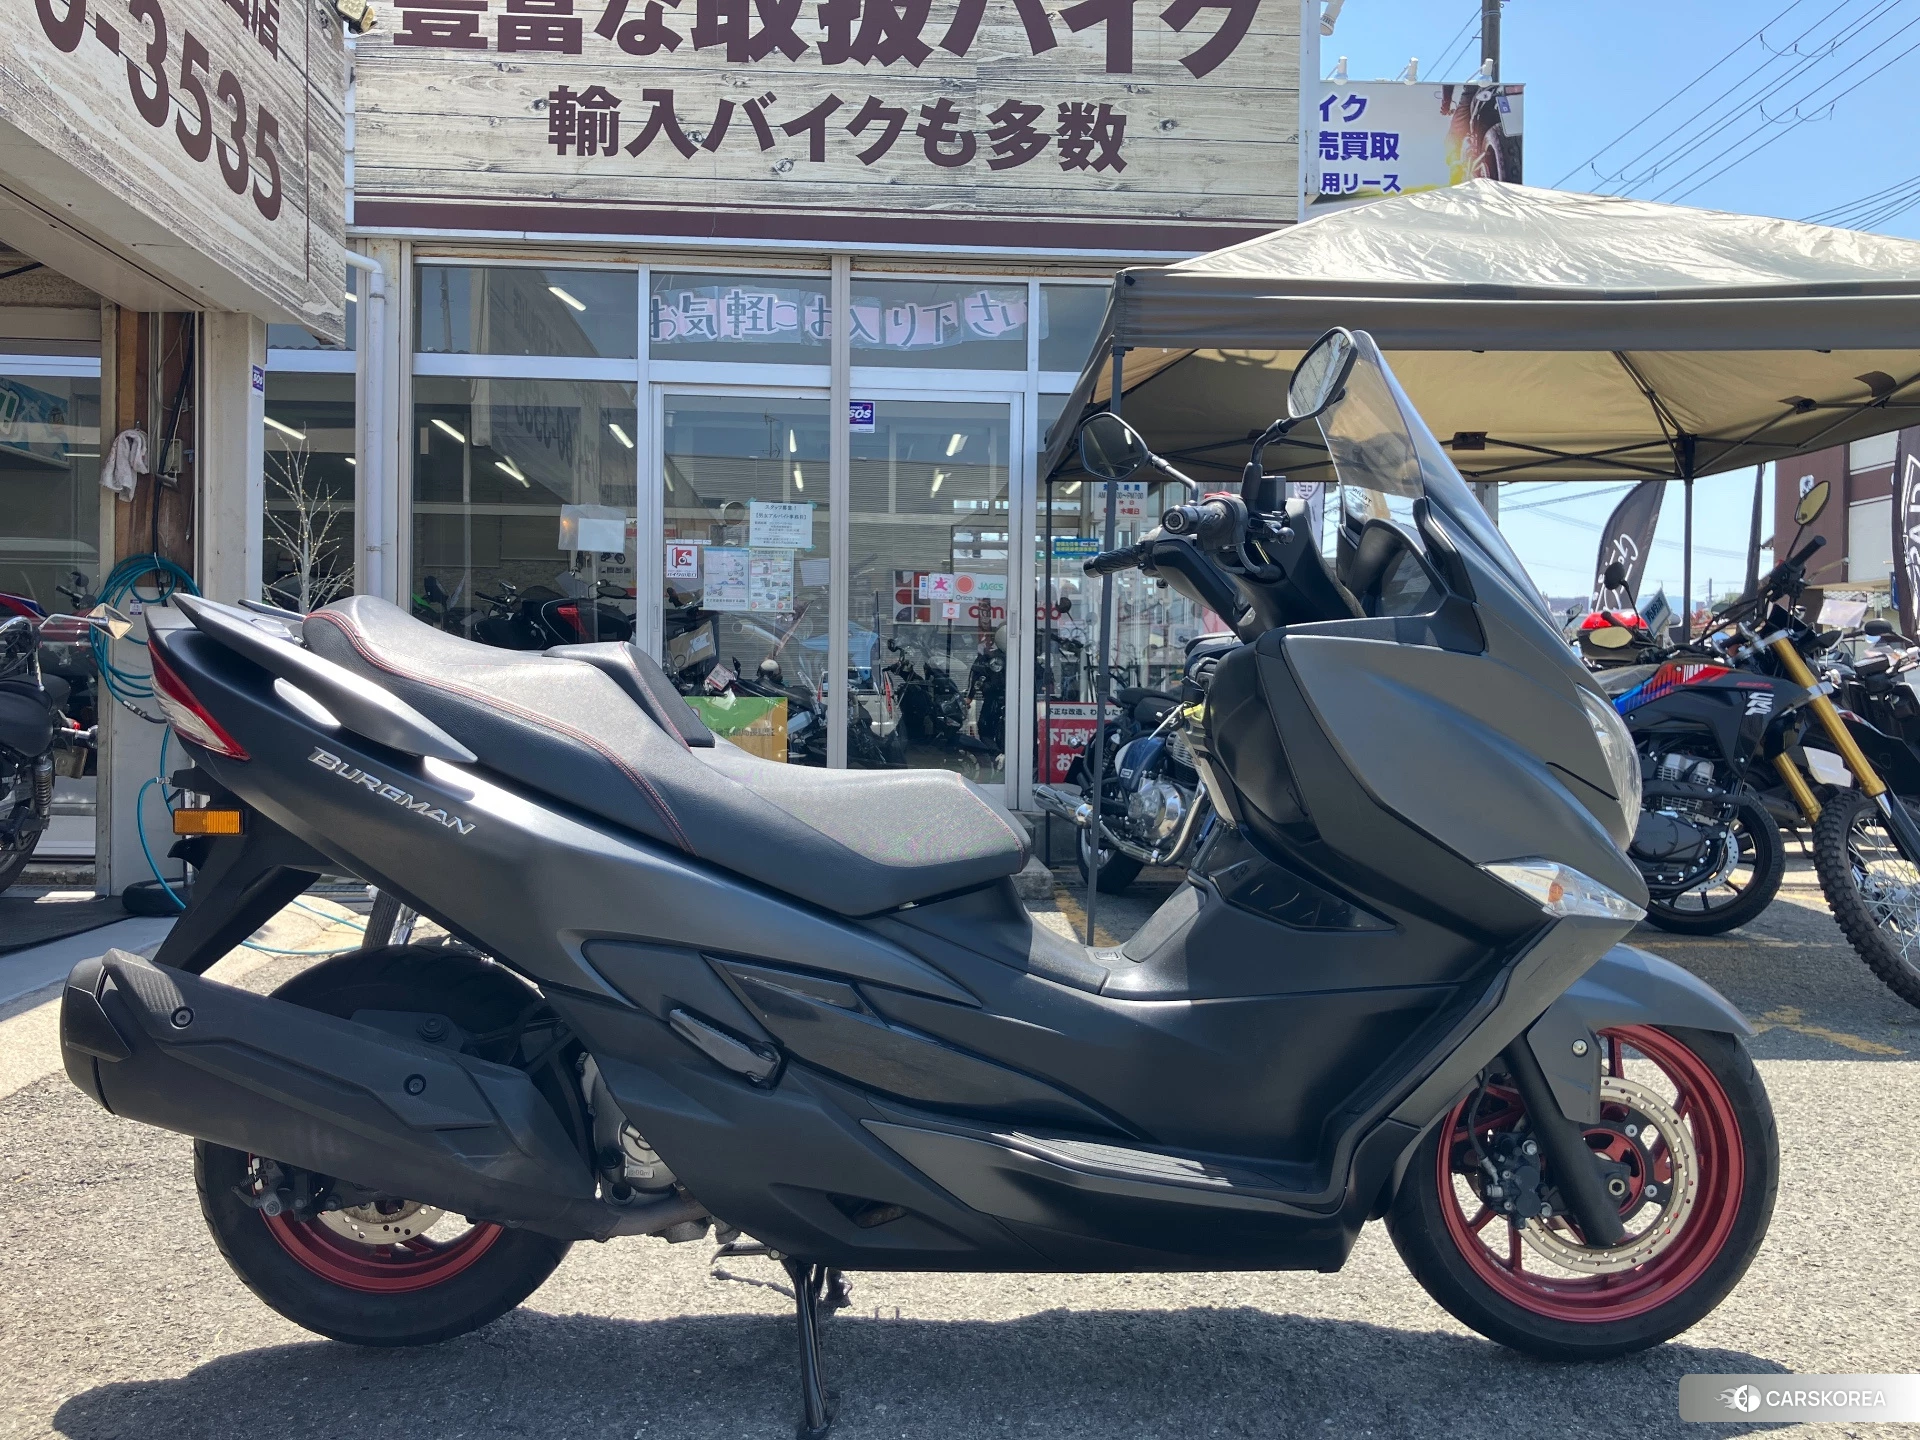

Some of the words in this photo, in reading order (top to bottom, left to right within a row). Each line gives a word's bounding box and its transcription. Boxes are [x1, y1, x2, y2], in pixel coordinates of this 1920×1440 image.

[548, 85, 1128, 174] 輸入バイクも多数
[1319, 131, 1400, 161] 売買取
[1321, 172, 1401, 193] 用リース
[849, 410, 872, 419] SOS
[307, 745, 477, 836] BURGMAN
